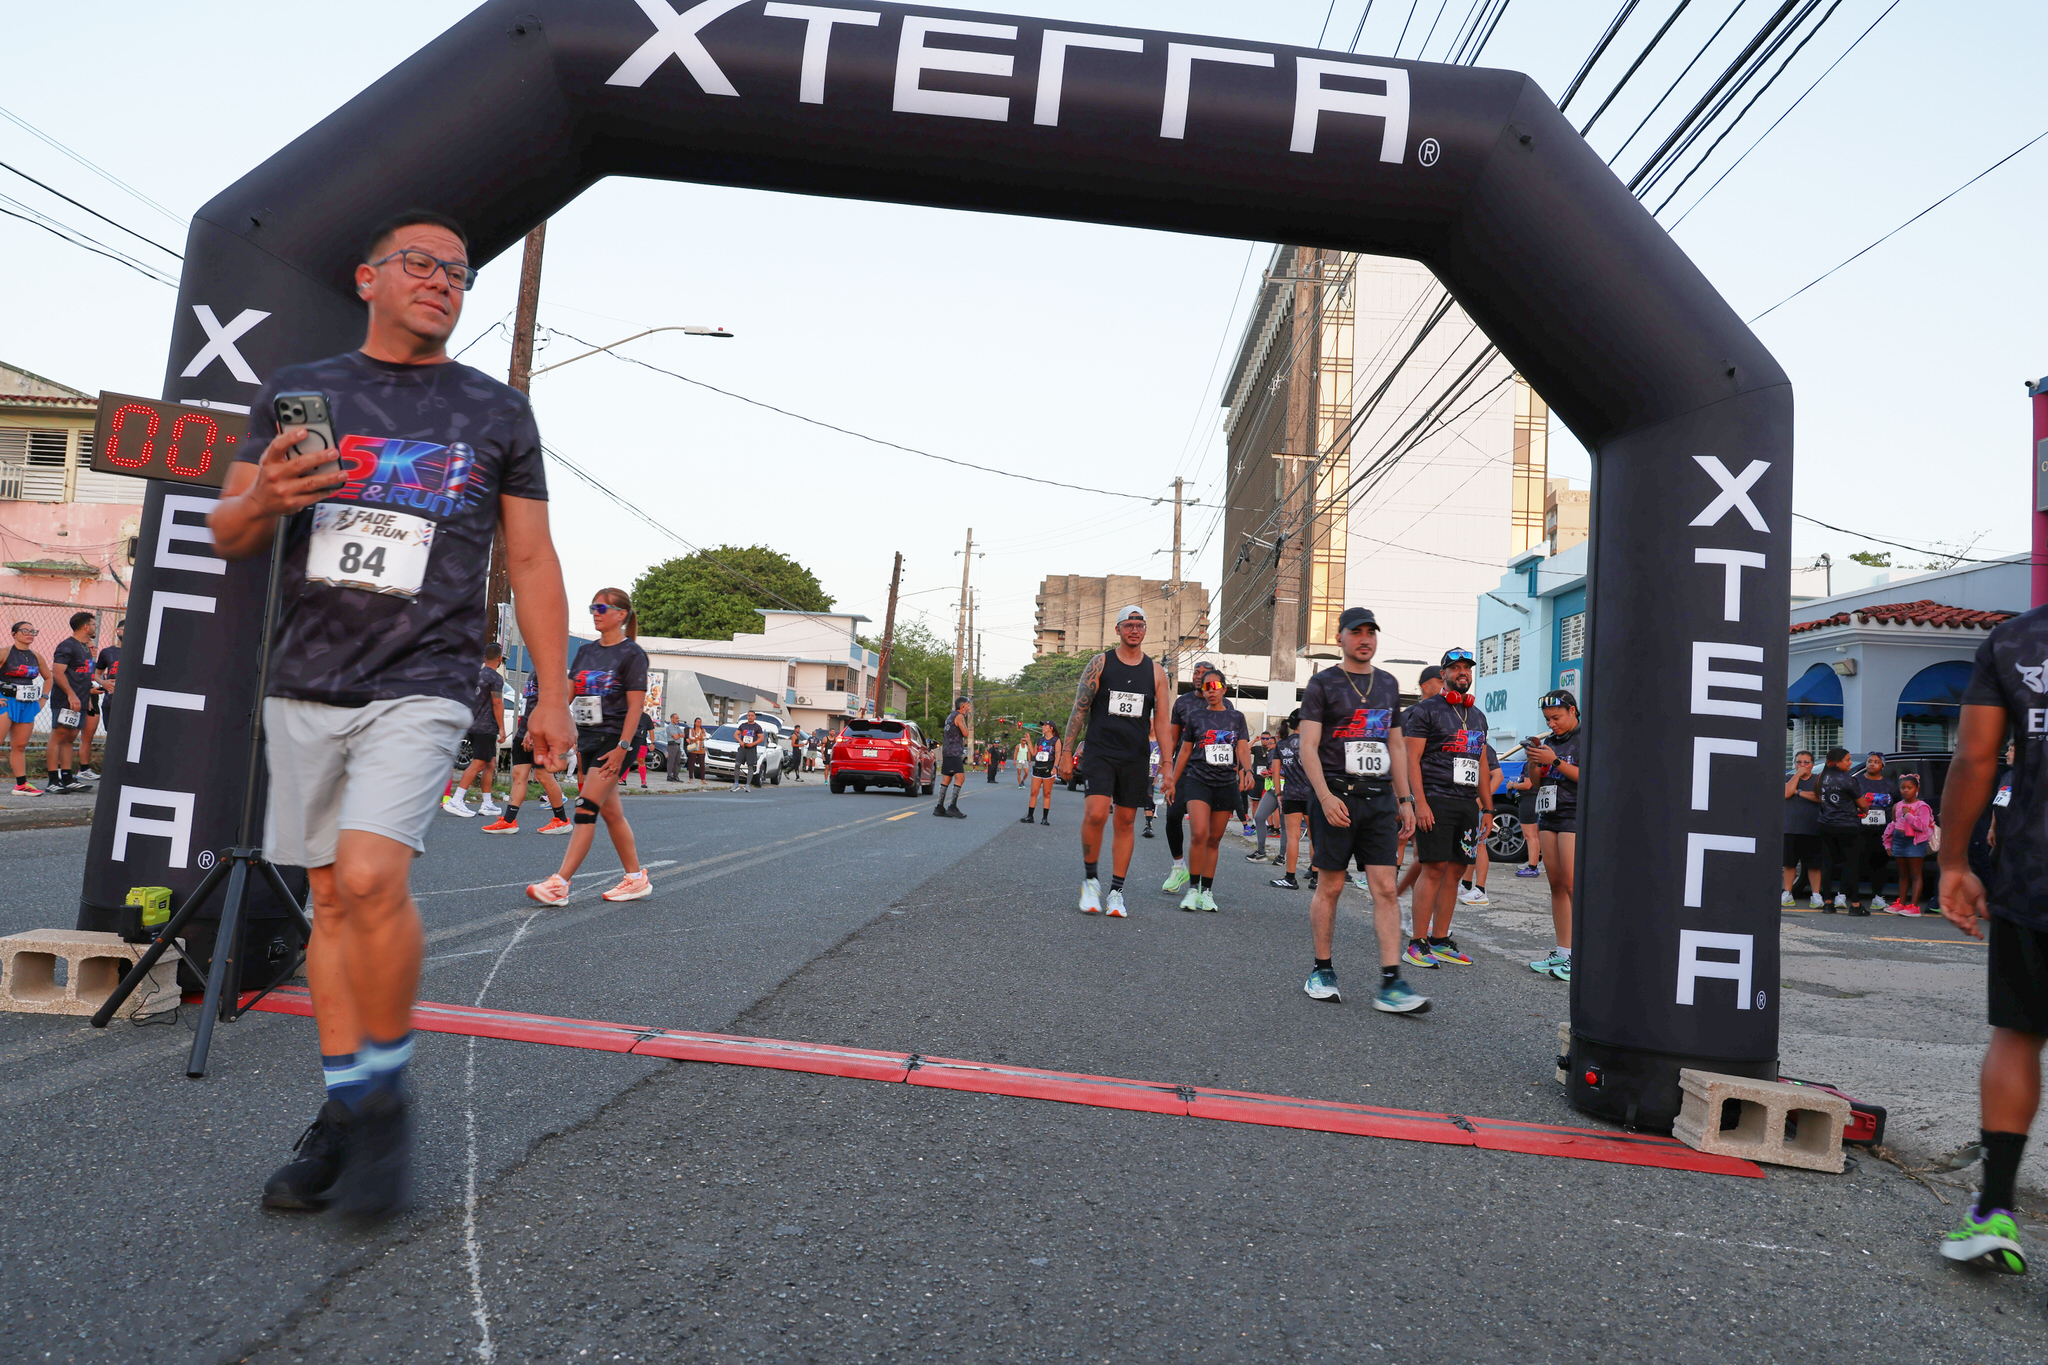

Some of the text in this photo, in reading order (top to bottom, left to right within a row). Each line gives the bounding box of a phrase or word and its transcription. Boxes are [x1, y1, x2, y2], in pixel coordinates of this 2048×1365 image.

[604, 0, 1410, 164] XTERRA
[338, 434, 448, 488] 5K
[354, 510, 397, 527] FADE
[371, 525, 409, 541] RUN
[339, 542, 387, 577] 84
[111, 305, 272, 868] XERRA
[22, 691, 36, 700] 183
[1119, 702, 1133, 713] 83
[64, 716, 77, 725] 182
[1348, 708, 1389, 729] 5K
[1204, 729, 1231, 743] 5K
[1454, 729, 1483, 746] 5K
[1676, 455, 1772, 1010] XTERRA
[1213, 753, 1229, 762] 164
[1357, 756, 1381, 771] 103
[1465, 770, 1476, 782] 28
[1538, 797, 1550, 809] 116
